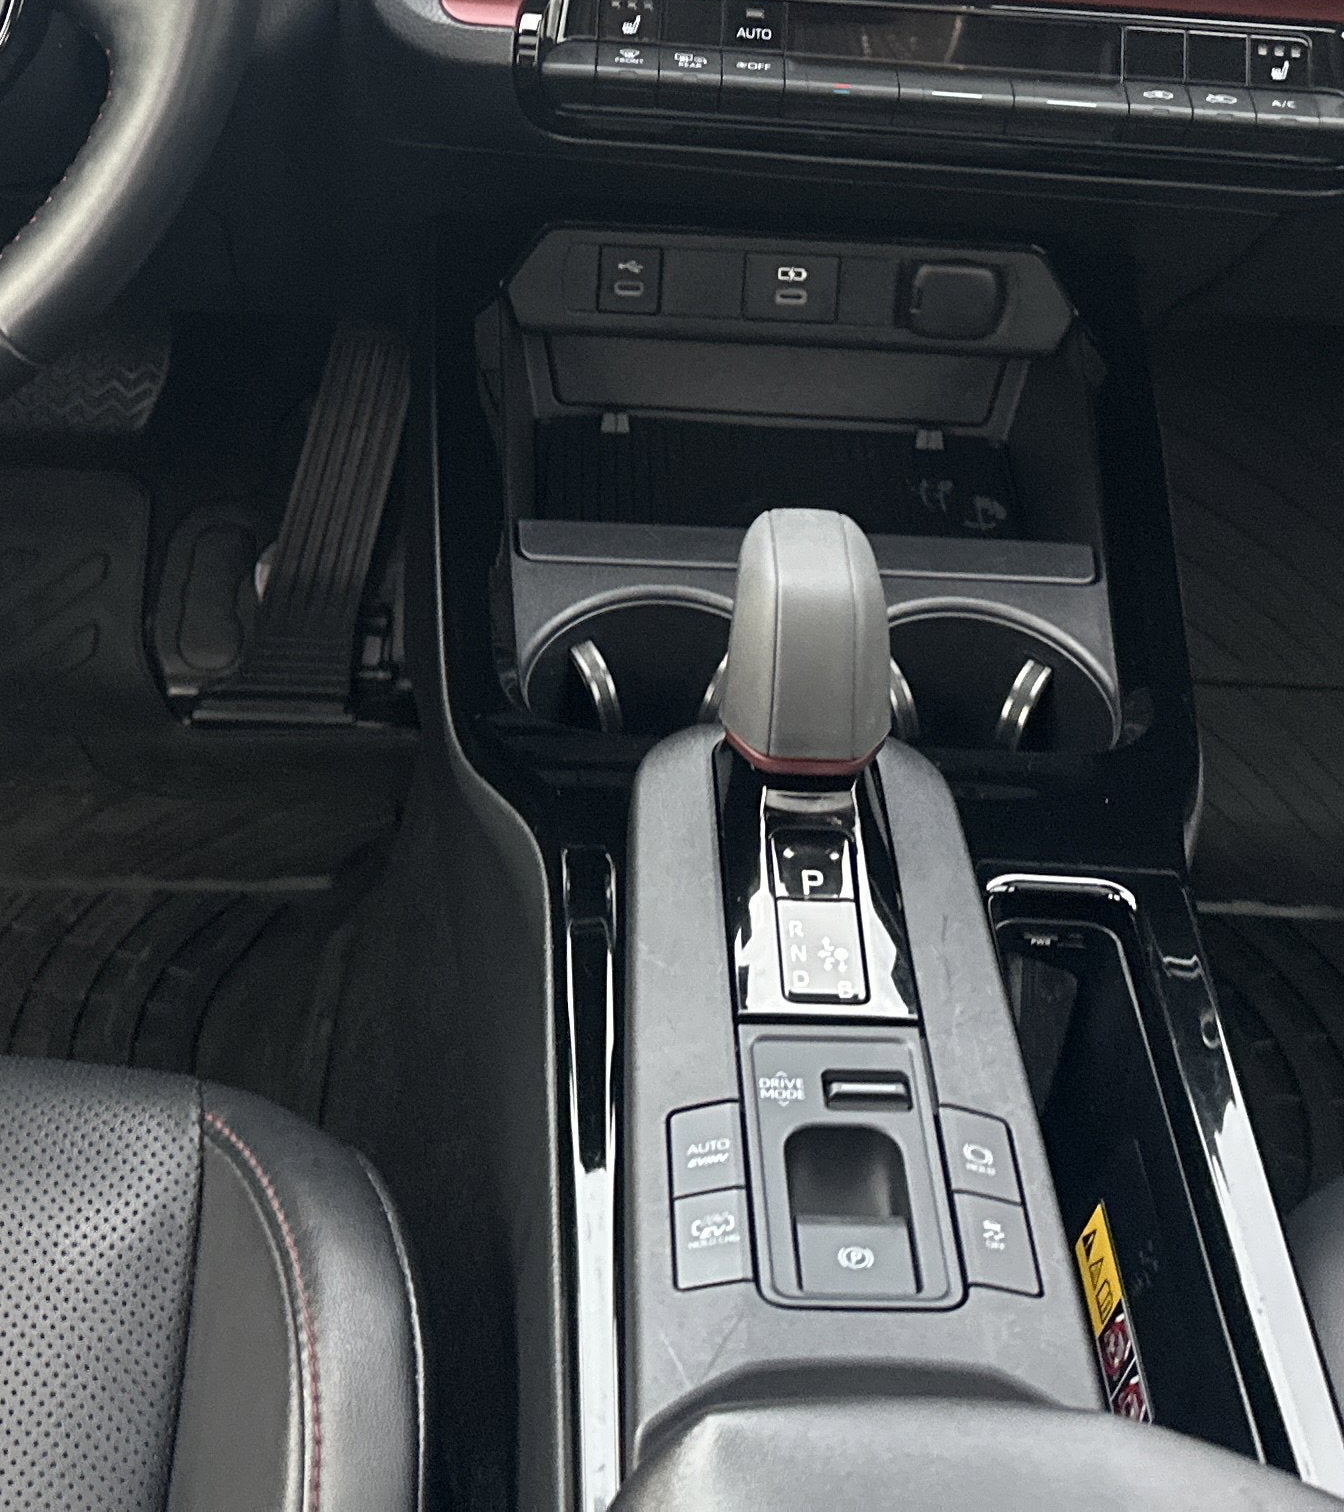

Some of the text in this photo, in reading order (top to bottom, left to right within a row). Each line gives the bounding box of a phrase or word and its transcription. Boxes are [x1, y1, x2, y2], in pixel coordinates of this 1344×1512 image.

[736, 26, 772, 41] AUTO
[678, 61, 703, 69] REAR
[747, 61, 771, 71] OFF
[1271, 99, 1296, 110] A/C
[801, 869, 824, 895] P
[789, 920, 804, 938] R
[791, 944, 806, 962] N
[793, 970, 809, 987] D
[837, 981, 854, 999] B
[758, 1077, 804, 1088] DRIVE
[759, 1088, 806, 1101] MODE
[686, 1138, 730, 1156] AUTO
